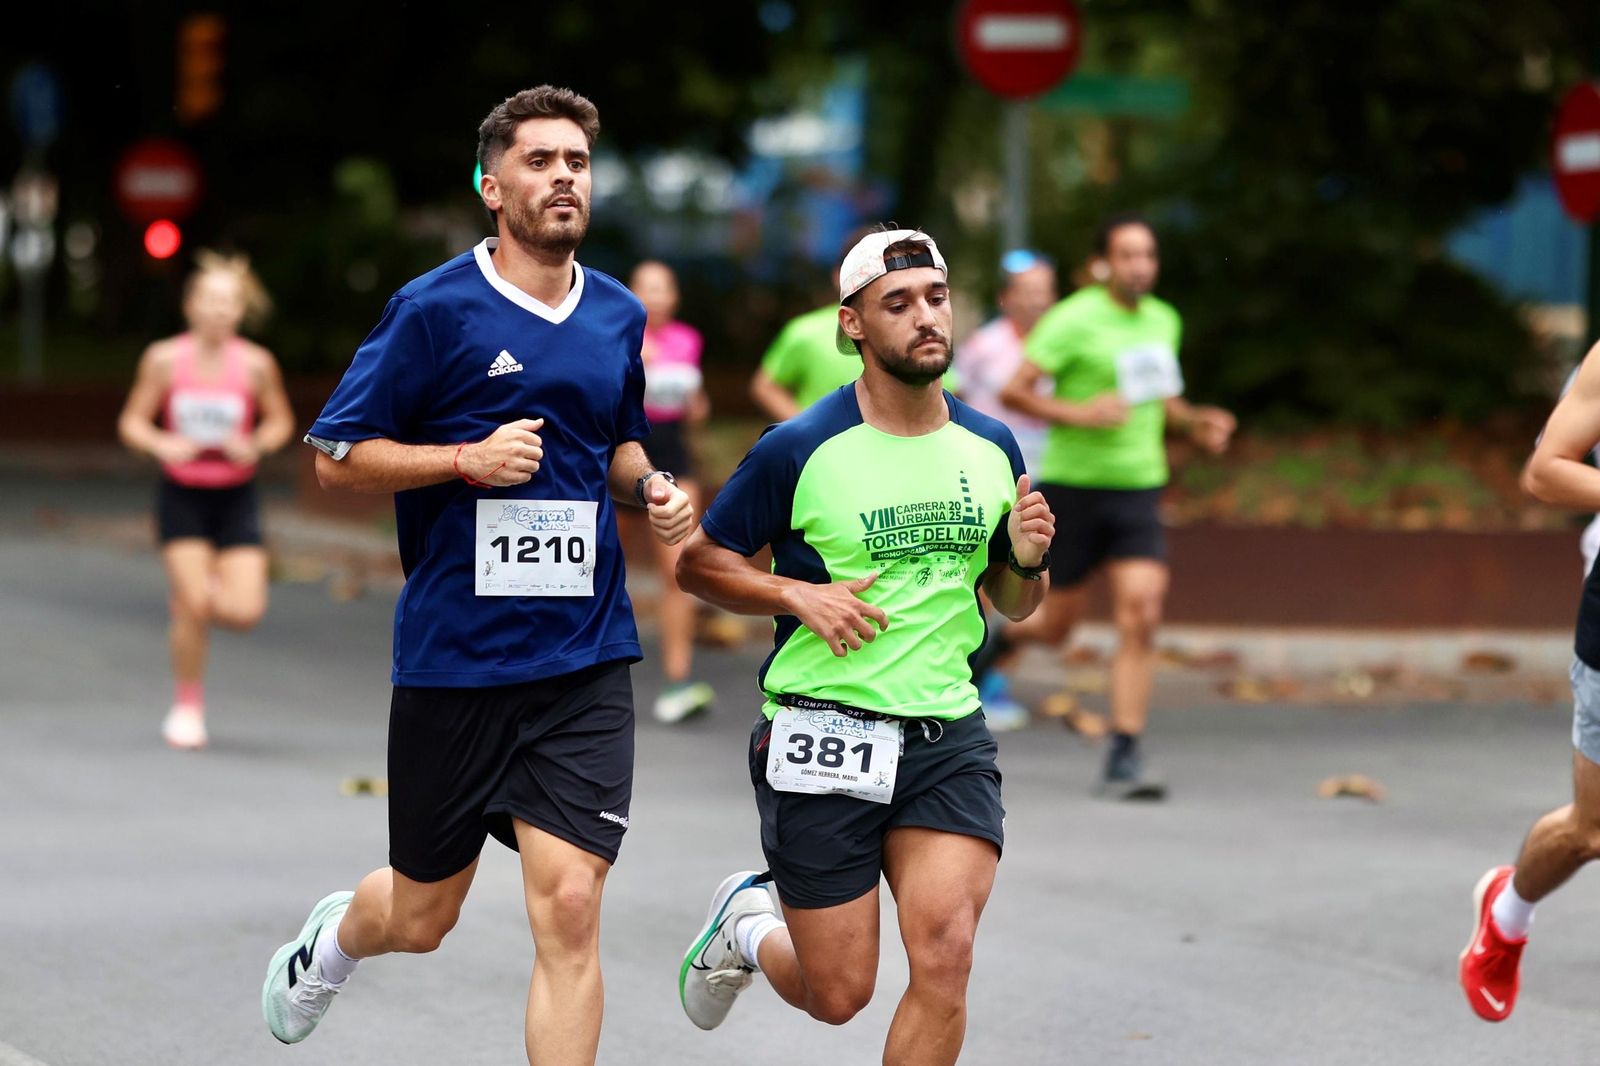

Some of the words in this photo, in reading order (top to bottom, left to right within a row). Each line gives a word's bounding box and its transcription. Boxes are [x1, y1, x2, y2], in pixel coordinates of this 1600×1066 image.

[488, 363, 523, 377] adidas
[896, 501, 946, 515] CARRERA
[949, 501, 961, 511] 20
[859, 506, 896, 532] VIII
[897, 510, 946, 525] URBANA
[949, 511, 961, 521] 25
[862, 529, 919, 551] TORRE
[923, 527, 953, 542] DEL
[958, 527, 988, 543] MAR
[490, 536, 585, 563] 1210
[798, 699, 865, 718] COMPRESORT
[786, 733, 874, 774] 381
[801, 768, 817, 777] GÓMEZ
[842, 774, 858, 783] MARIO
